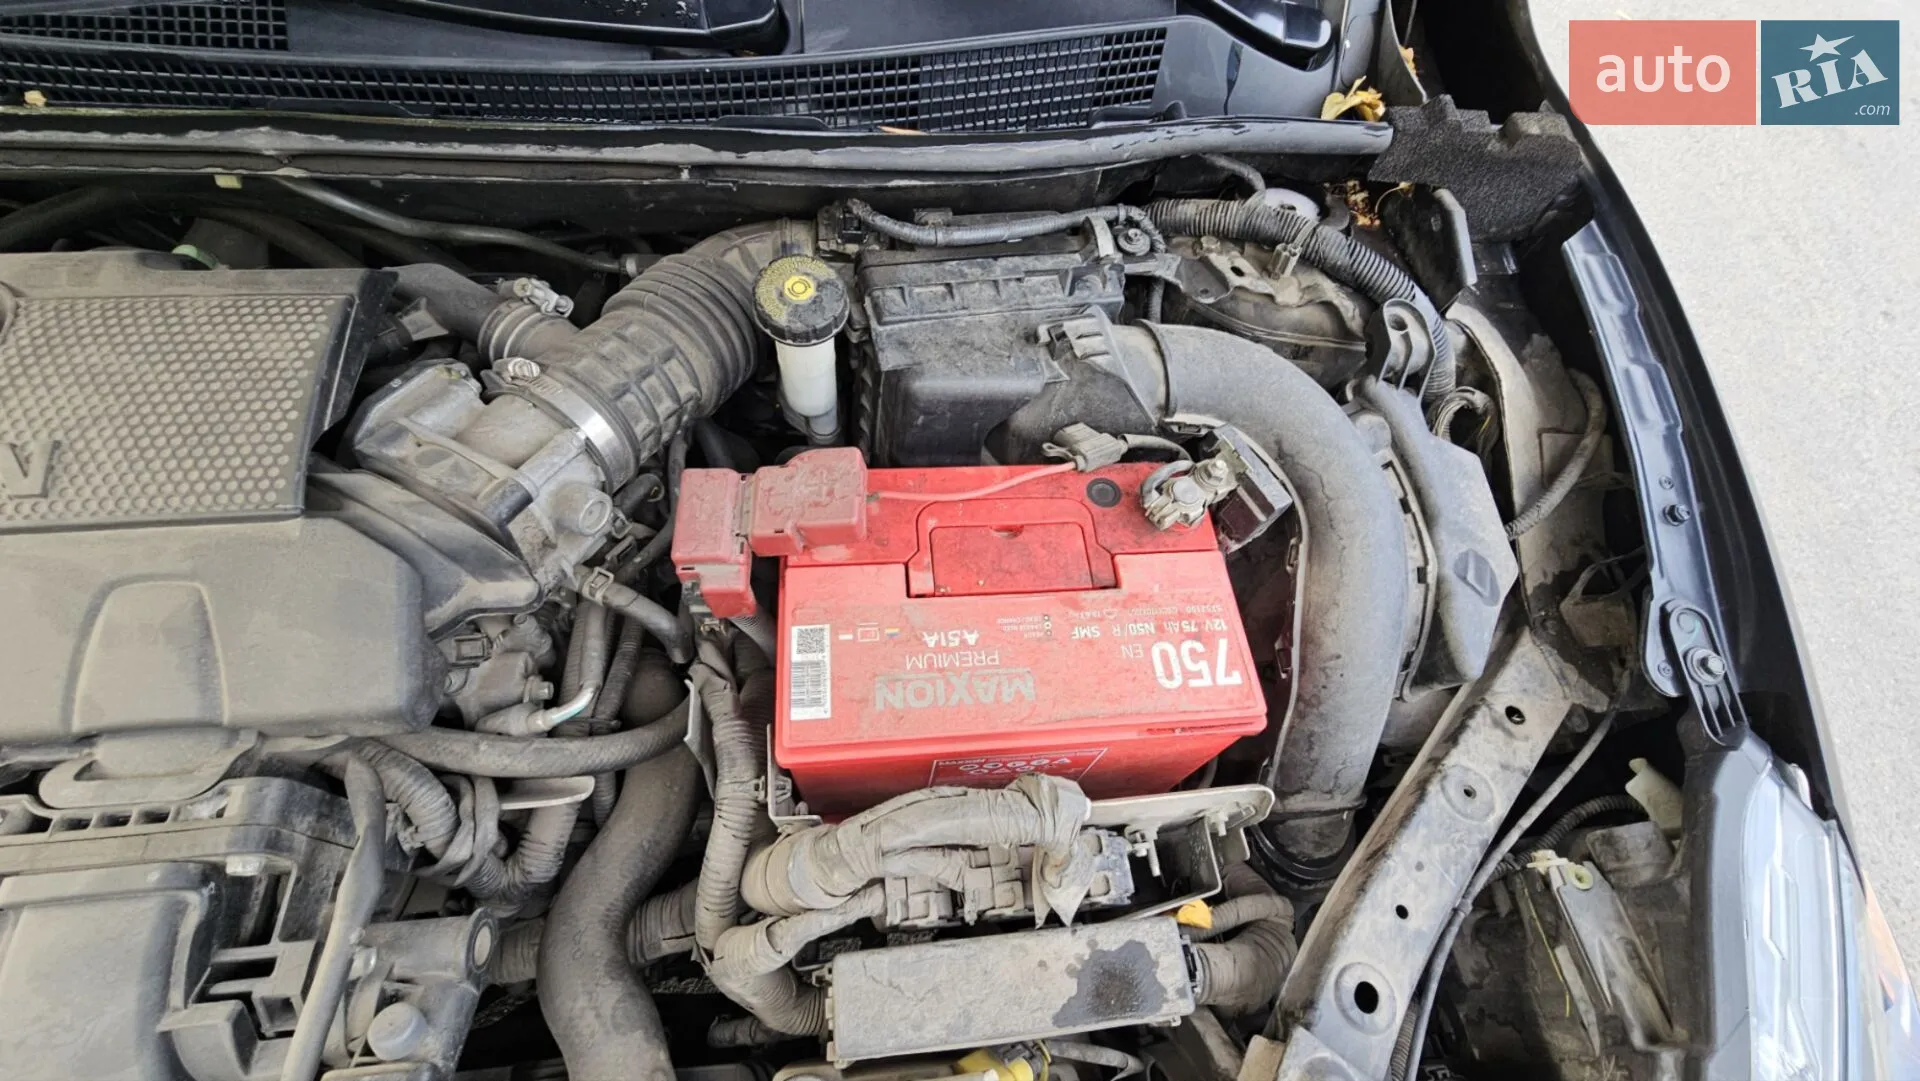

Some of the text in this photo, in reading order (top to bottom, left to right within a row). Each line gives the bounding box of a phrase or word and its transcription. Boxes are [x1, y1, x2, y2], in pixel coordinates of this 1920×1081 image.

[1071, 625, 1101, 640] SMF
[1204, 618, 1228, 632] 12V
[922, 629, 980, 648] ASIA
[905, 650, 1000, 670] PREMIUM
[1121, 637, 1243, 689] 750 EN
[874, 669, 1037, 711] MAXION
